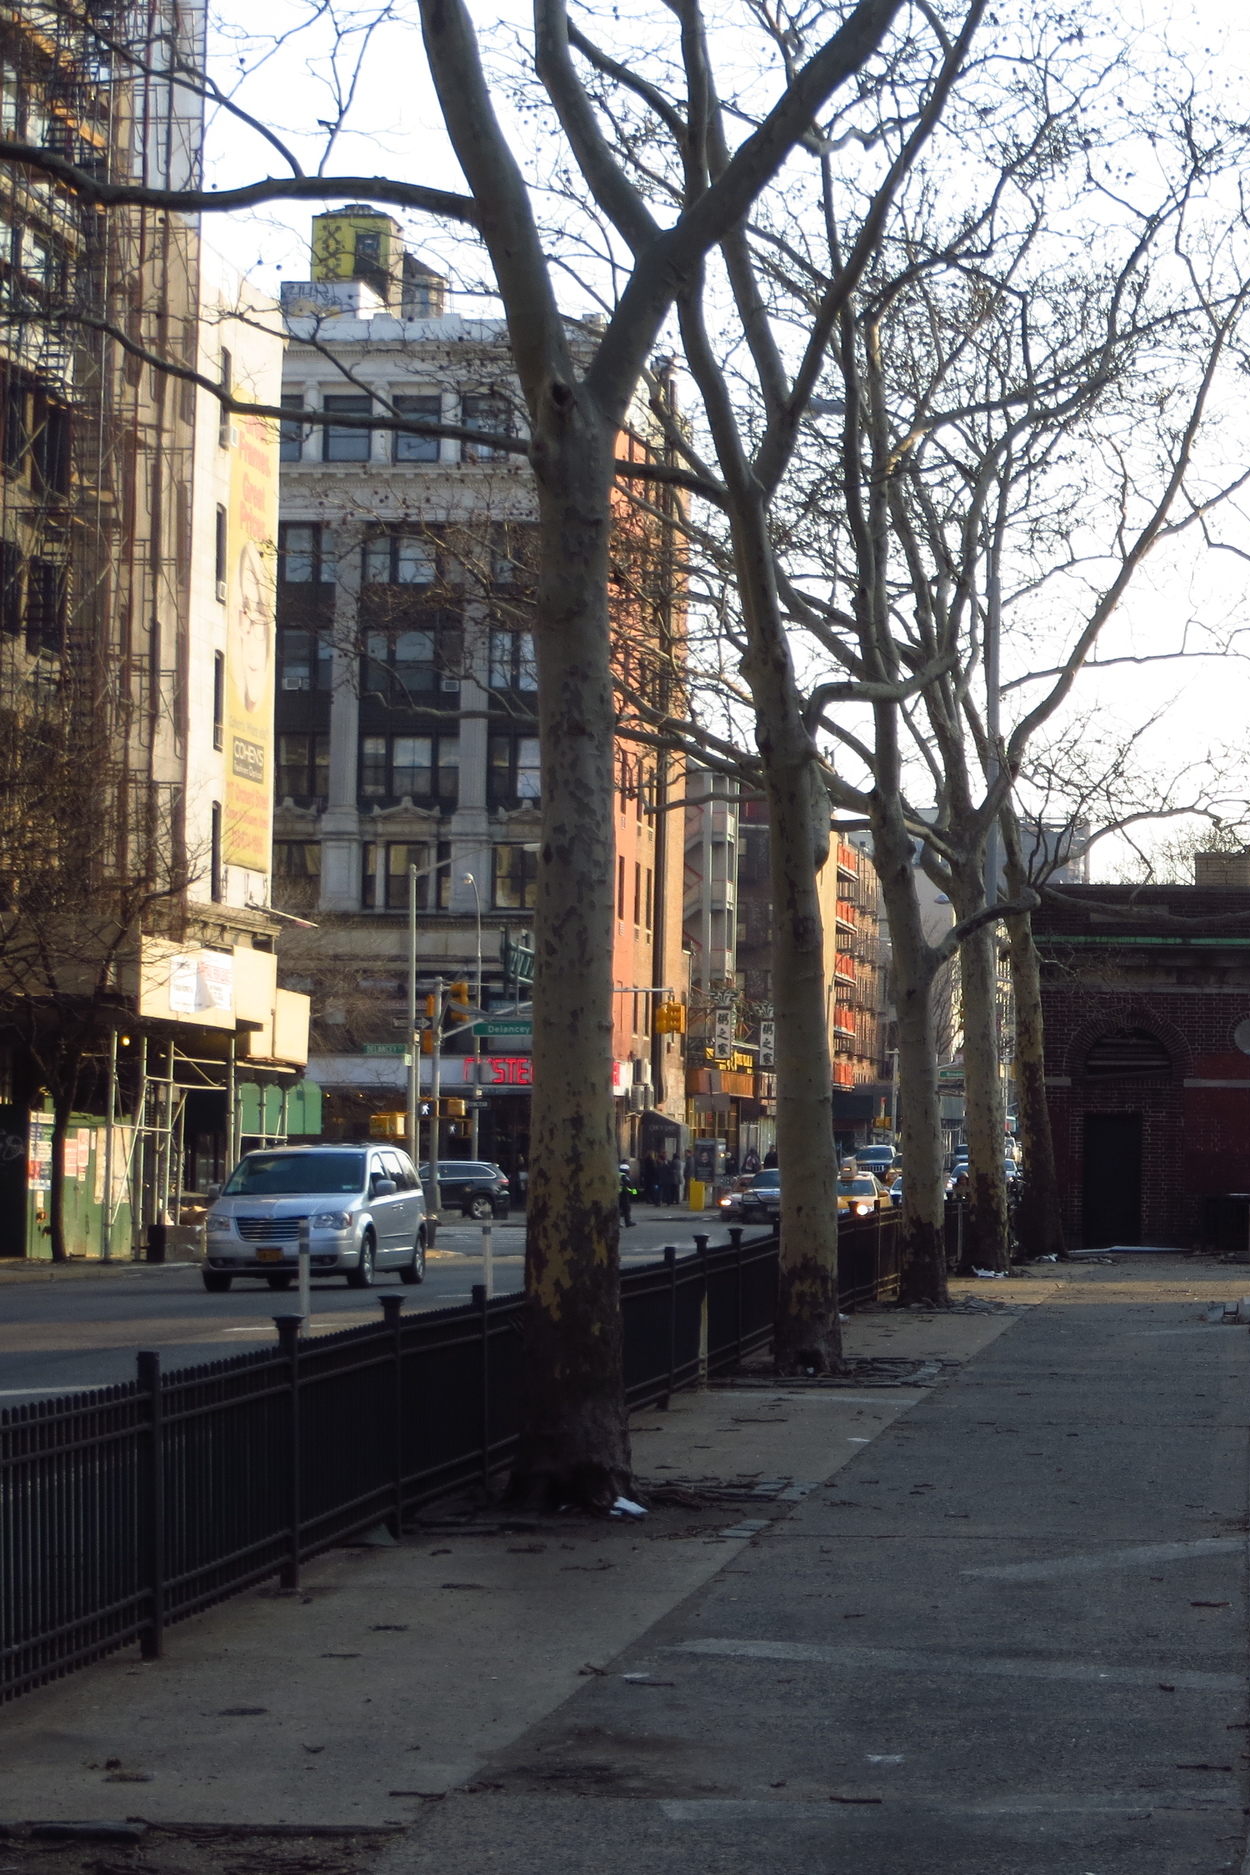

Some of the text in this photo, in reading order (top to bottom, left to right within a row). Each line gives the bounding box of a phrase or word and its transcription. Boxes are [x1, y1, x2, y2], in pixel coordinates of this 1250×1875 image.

[487, 1025, 531, 1035] Delancey
[717, 1012, 729, 1056] 粥之家
[366, 1045, 397, 1054] DELANCEY
[762, 1023, 774, 1065] 粥之家
